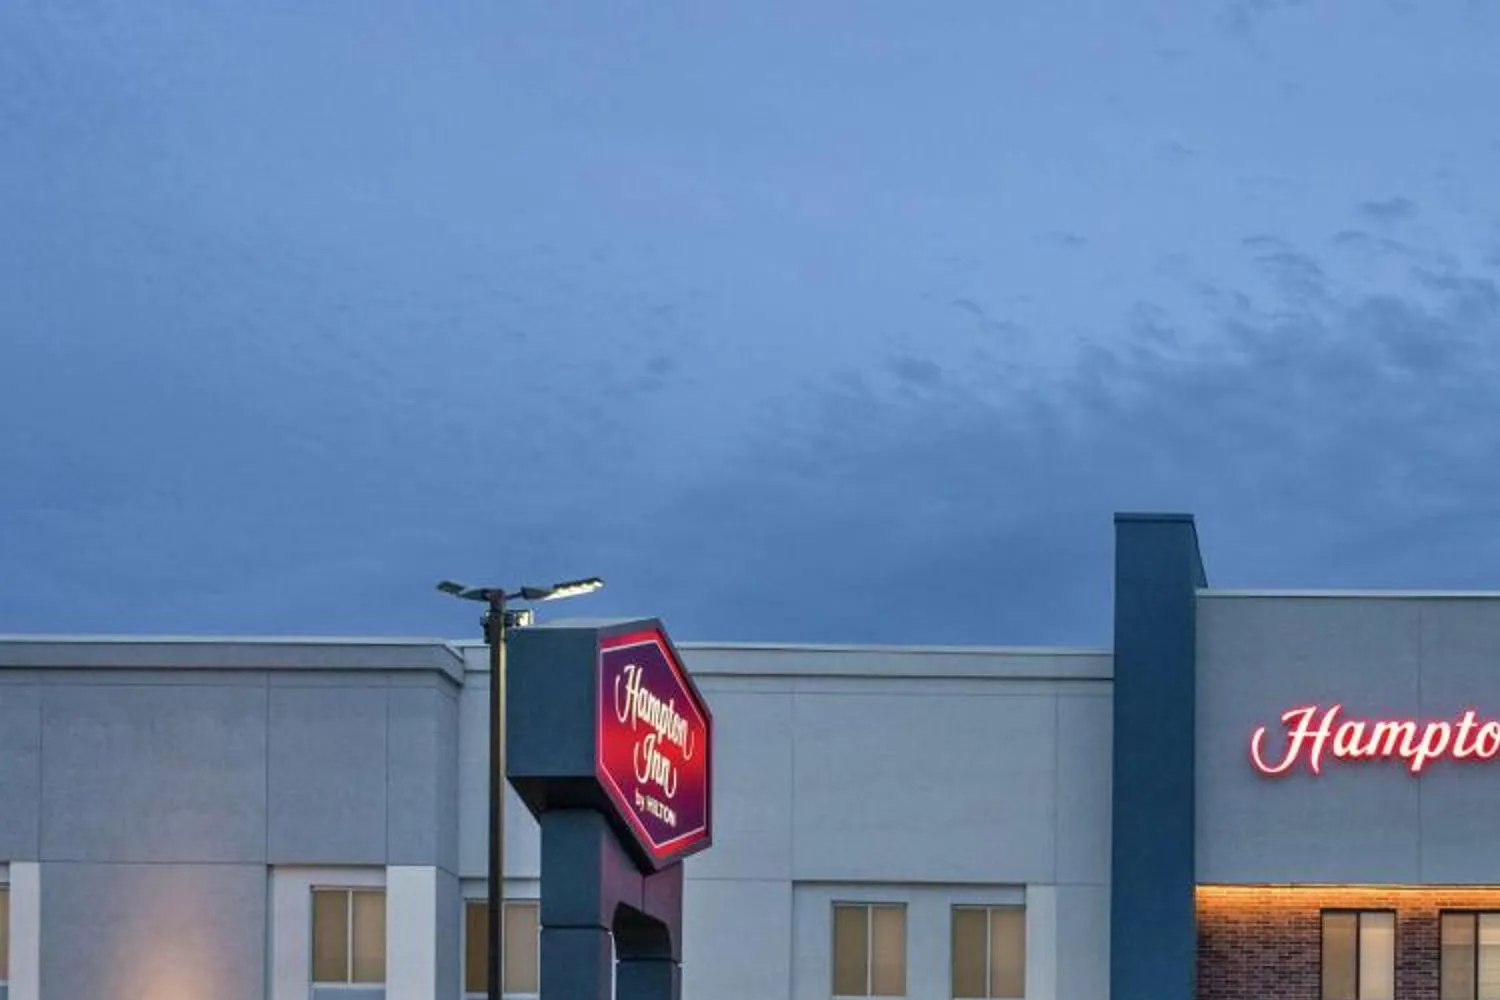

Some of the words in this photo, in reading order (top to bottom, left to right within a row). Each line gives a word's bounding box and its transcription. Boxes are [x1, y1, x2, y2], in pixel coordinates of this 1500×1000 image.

[615, 664, 695, 760] Hampton
[634, 734, 677, 798] Inn
[635, 788, 645, 811] by
[645, 795, 676, 827] HILTON
